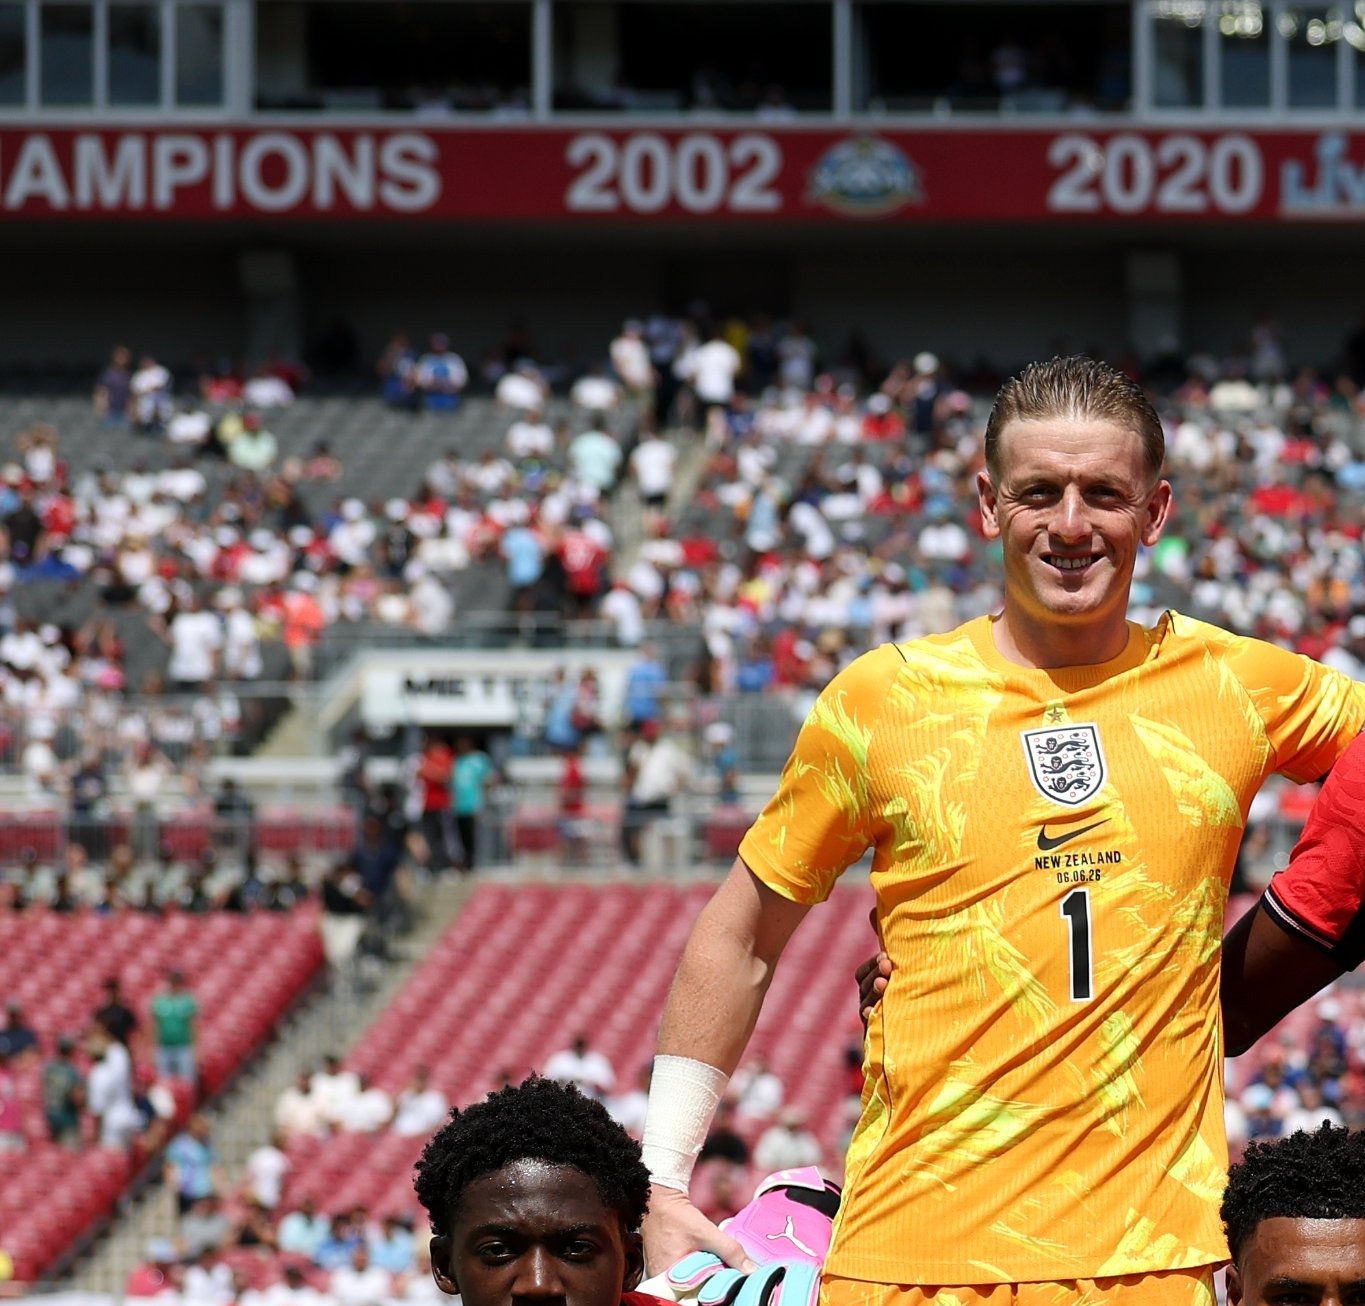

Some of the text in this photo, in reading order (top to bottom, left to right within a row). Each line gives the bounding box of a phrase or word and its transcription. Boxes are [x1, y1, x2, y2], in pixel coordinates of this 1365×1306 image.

[5, 132, 442, 212] AMPIONS
[565, 134, 782, 212] 2002
[1047, 134, 1263, 213] 2020
[1034, 850, 1122, 870] NEW ZEALAND
[1056, 869, 1101, 884] 06.06.26
[1060, 889, 1094, 1002] 1
